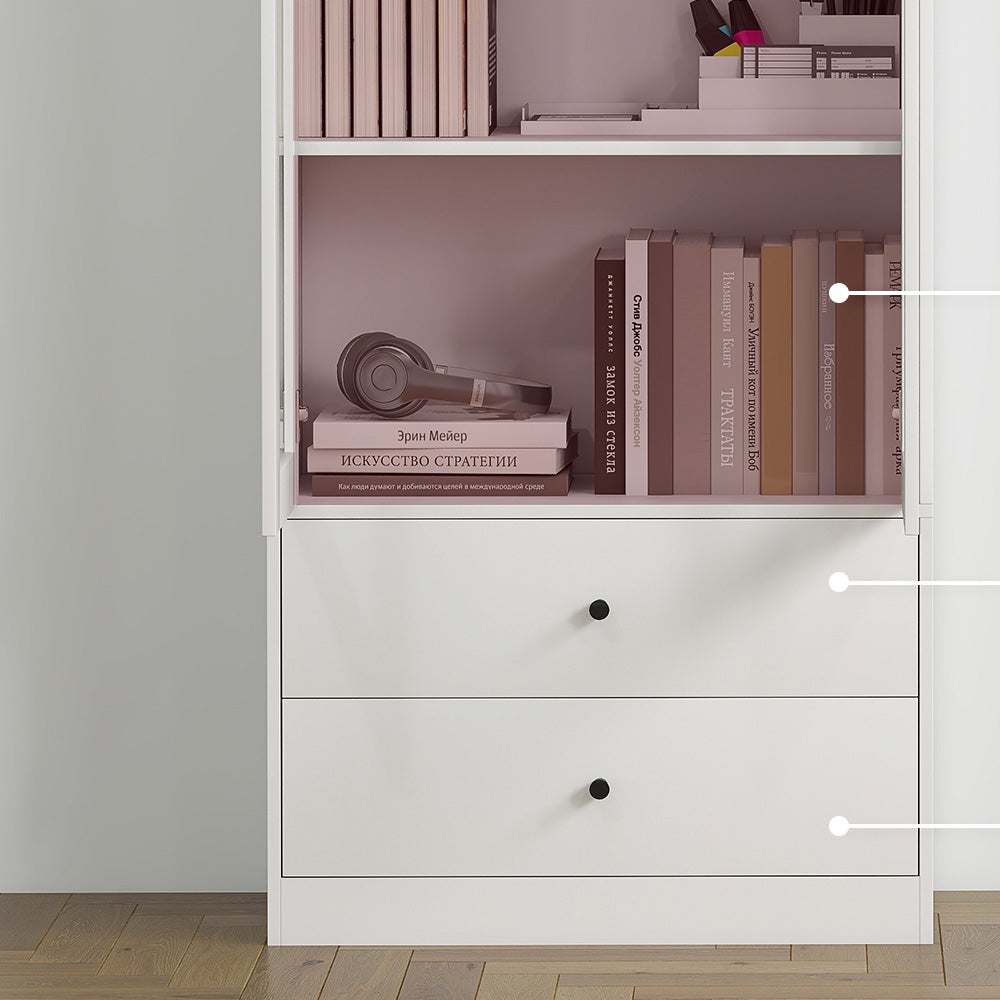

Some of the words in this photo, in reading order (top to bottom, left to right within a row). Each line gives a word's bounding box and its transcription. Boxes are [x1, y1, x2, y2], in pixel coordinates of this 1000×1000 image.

[633, 294, 642, 320] Стив
[721, 271, 734, 332] Иммануил
[632, 322, 643, 357] Джобс
[721, 338, 734, 368] Кант
[747, 327, 759, 375] Уличный
[606, 365, 616, 405] замок
[632, 359, 642, 396] Уолтер
[748, 378, 756, 396] кот
[820, 344, 835, 410] Избранное
[606, 411, 616, 425] из
[748, 399, 756, 412] по
[397, 430, 426, 444] Эрин
[429, 430, 468, 444] Мейер
[633, 398, 643, 448] Айзексон
[720, 388, 734, 466] ТРАКТАТЫ
[748, 414, 756, 448] имени
[341, 455, 430, 467] ИСКУССТВО
[435, 455, 517, 467] СТРАТЕГИИ
[606, 430, 616, 474] стекла
[748, 450, 759, 471] Боб
[402, 483, 442, 491] добиваются
[443, 483, 463, 491] целей
[470, 483, 523, 491] международной
